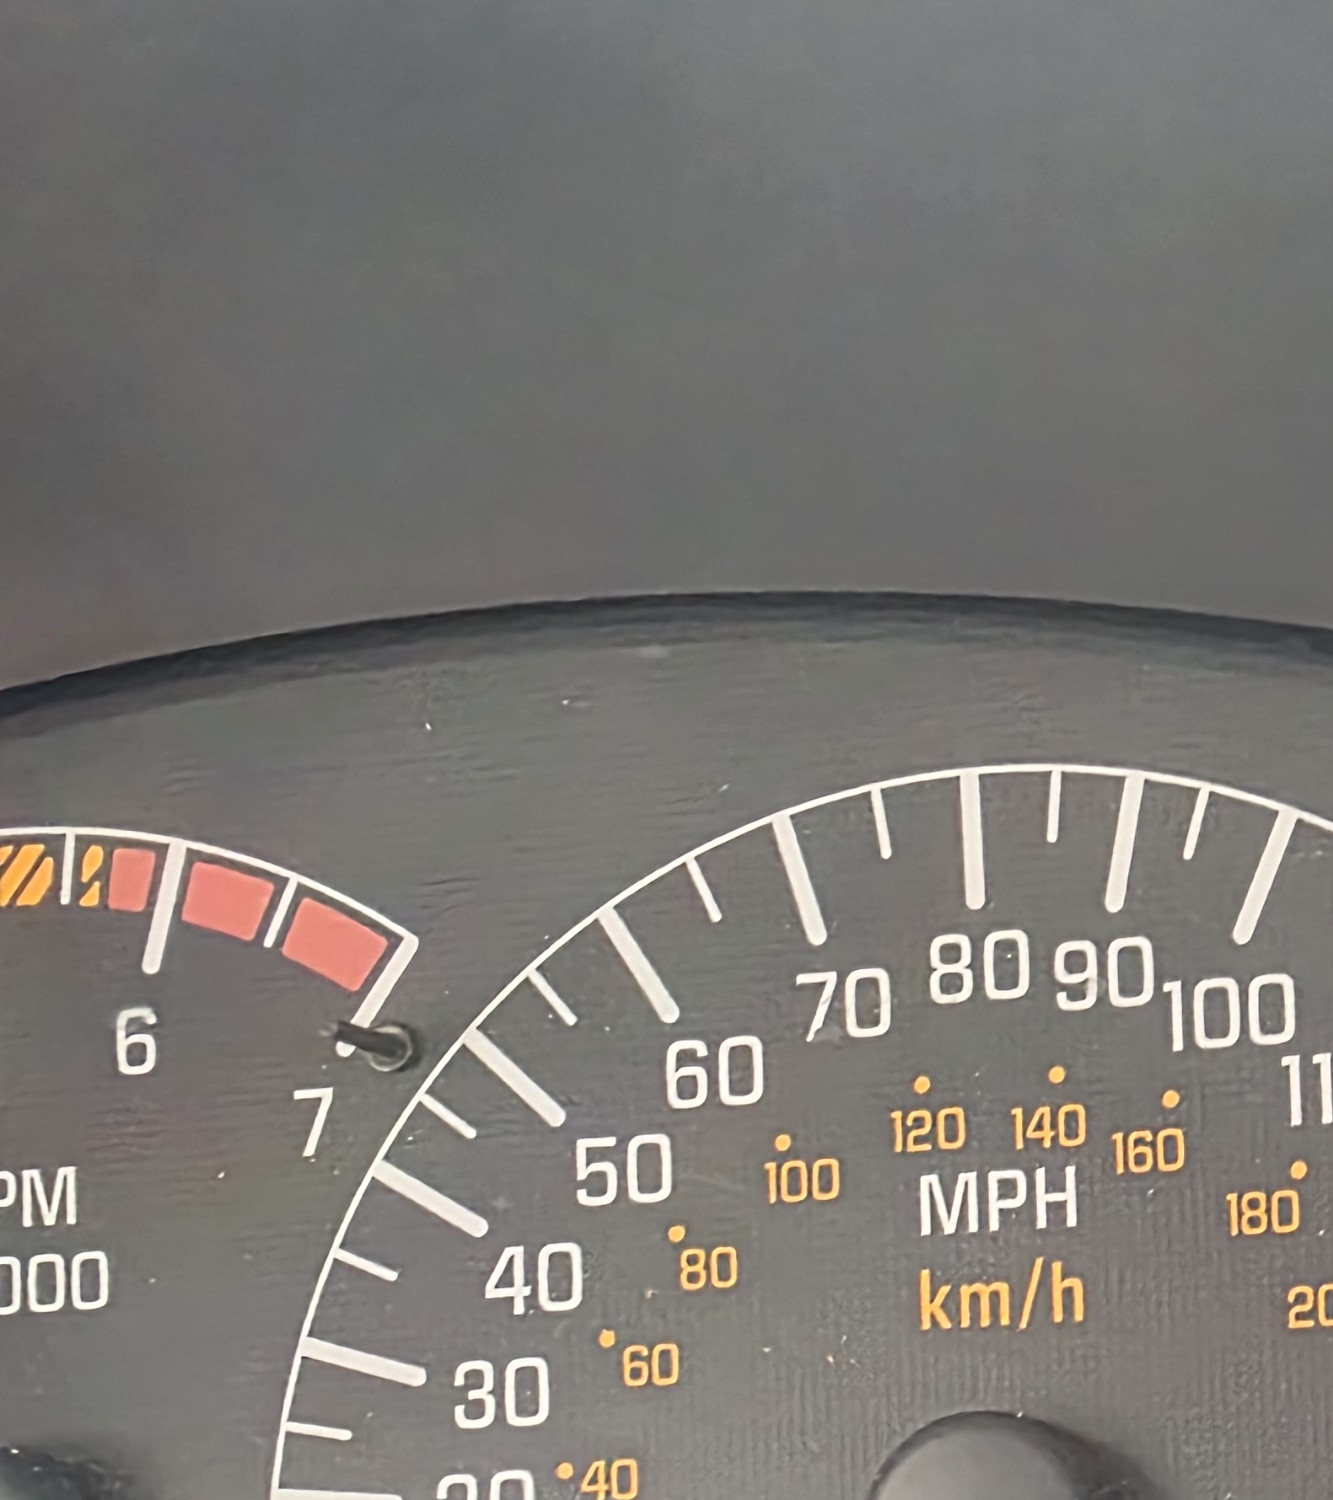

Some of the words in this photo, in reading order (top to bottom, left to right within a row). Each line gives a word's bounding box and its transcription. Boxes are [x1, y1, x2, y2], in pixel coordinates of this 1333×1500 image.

[928, 928, 1031, 1005] 80
[1052, 935, 1156, 1012] 90
[115, 1006, 158, 1076] 6
[794, 966, 892, 1044] 70
[1161, 972, 1297, 1053] 100
[664, 1034, 765, 1110] 60
[292, 1085, 335, 1158] 7
[889, 1105, 967, 1154] 120
[1010, 1102, 1088, 1151] 140
[1110, 1126, 1186, 1176] 160
[574, 1132, 673, 1208] 50
[763, 1157, 841, 1205] 100
[918, 1164, 1078, 1238] MPH
[1224, 1188, 1301, 1238] 180
[483, 1241, 584, 1317] 40
[679, 1245, 739, 1292] 80
[918, 1255, 1085, 1332] km/h
[452, 1355, 551, 1430] 30
[621, 1342, 680, 1388] 60
